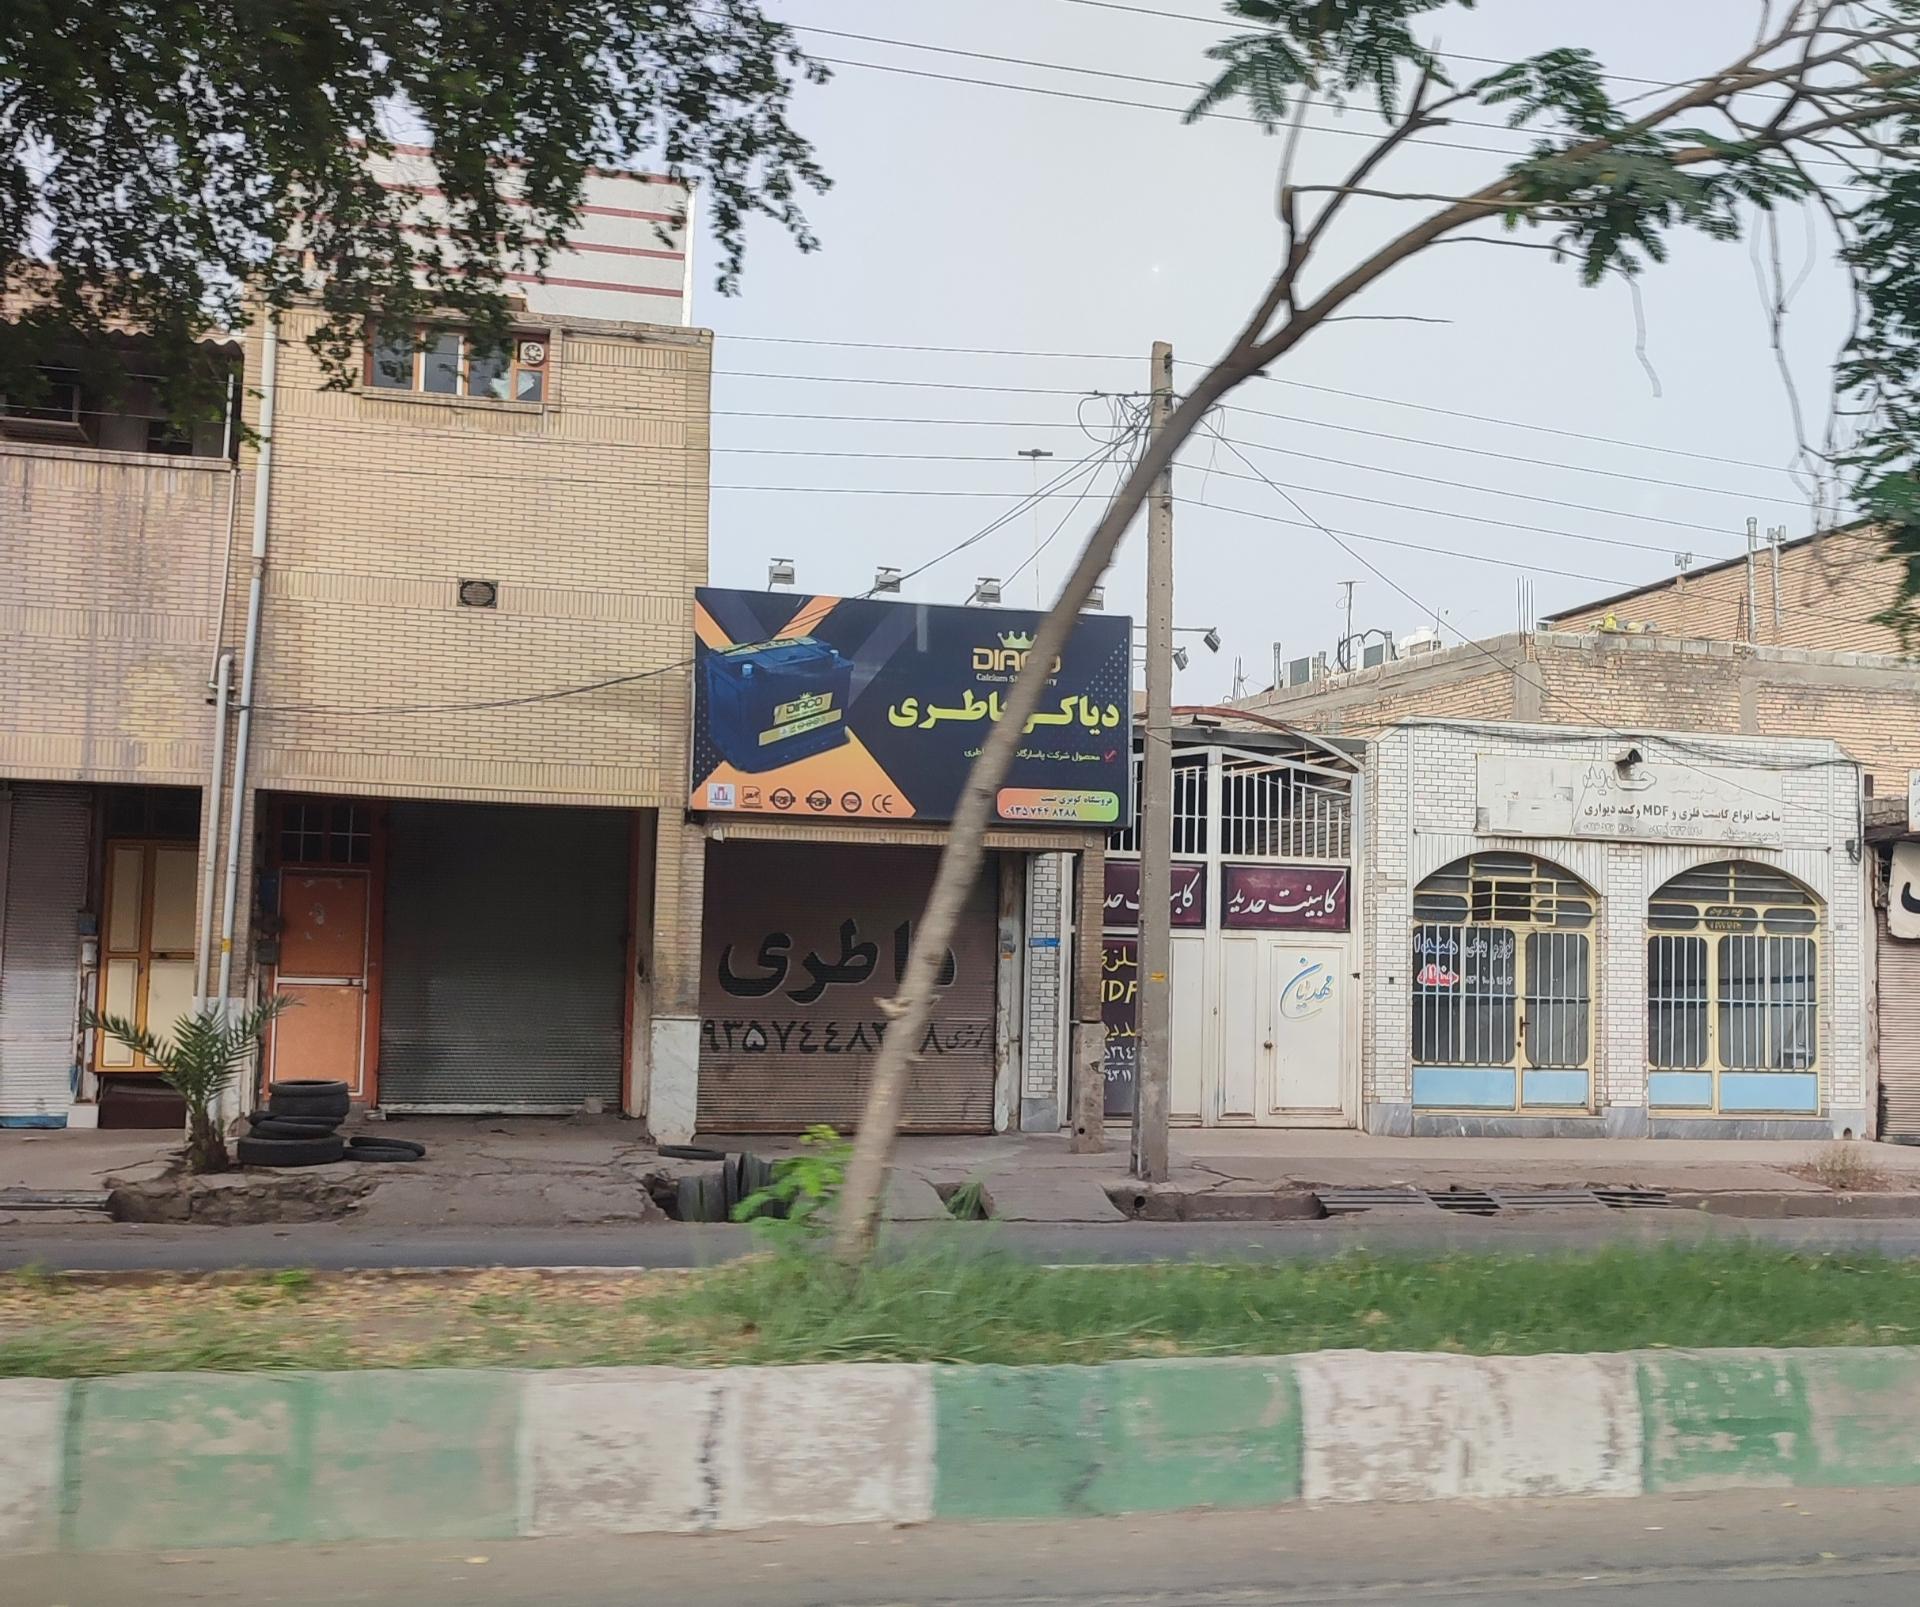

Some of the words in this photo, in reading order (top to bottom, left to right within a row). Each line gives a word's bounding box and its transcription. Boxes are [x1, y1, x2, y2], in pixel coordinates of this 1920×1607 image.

[785, 696, 823, 715] DIACO
[1047, 750, 1070, 761] شرکت
[1072, 752, 1101, 762] محصول
[1584, 802, 1616, 817] دیواری
[1642, 804, 1669, 816] MDF
[1678, 807, 1700, 821] فلزی
[1732, 809, 1753, 823] انواع
[1228, 888, 1267, 914] حدید
[1268, 875, 1345, 918] کابینت
